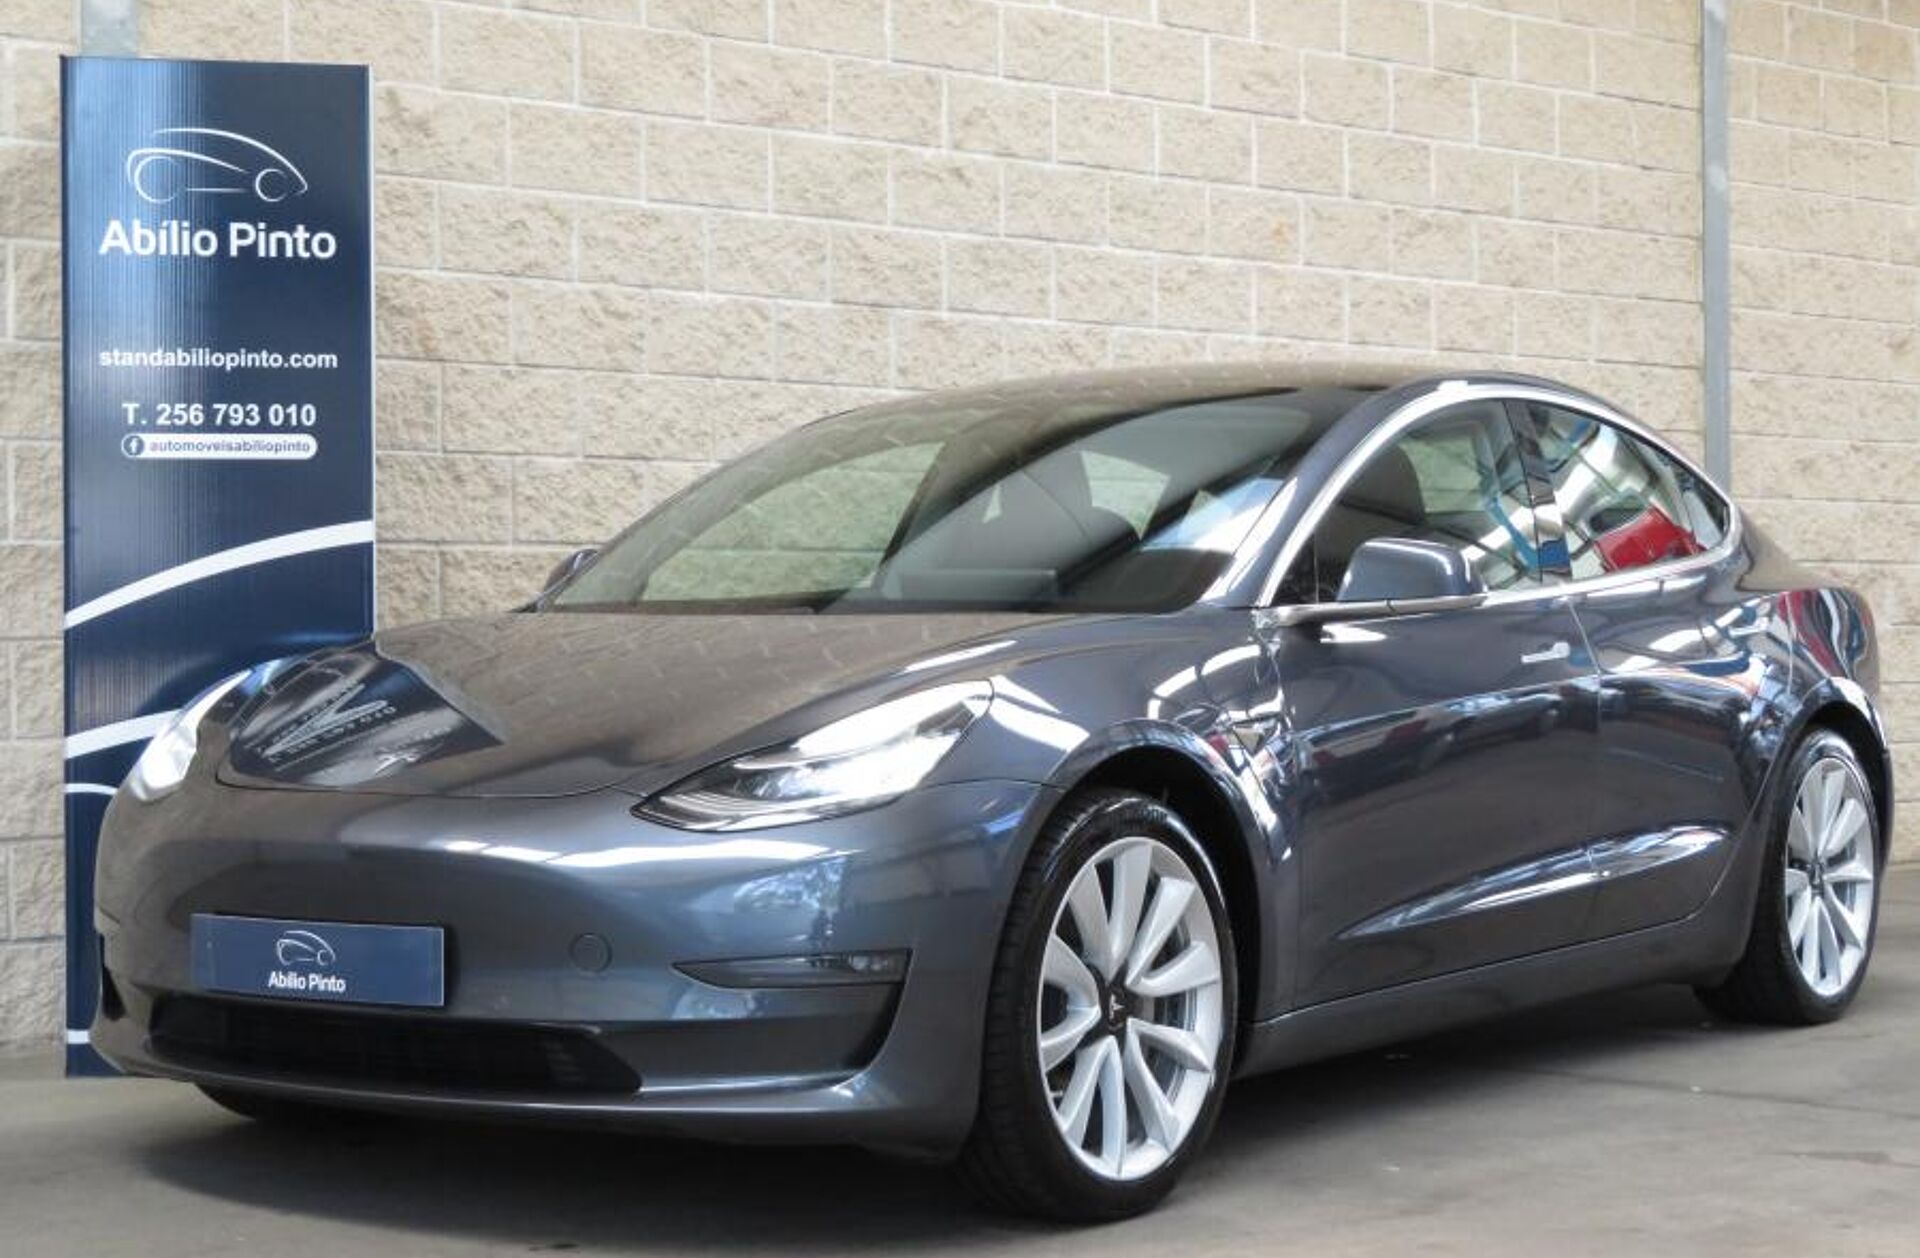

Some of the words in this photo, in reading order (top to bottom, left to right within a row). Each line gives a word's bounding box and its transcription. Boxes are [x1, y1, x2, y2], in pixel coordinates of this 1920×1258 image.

[98, 219, 218, 257] Abílio
[229, 222, 337, 259] Pinto
[99, 348, 338, 372] standabiliopinto.com
[121, 403, 147, 426] T.
[156, 403, 204, 427] 256
[213, 403, 260, 426] 793
[269, 403, 316, 427] 010
[309, 973, 346, 993] Pinto
